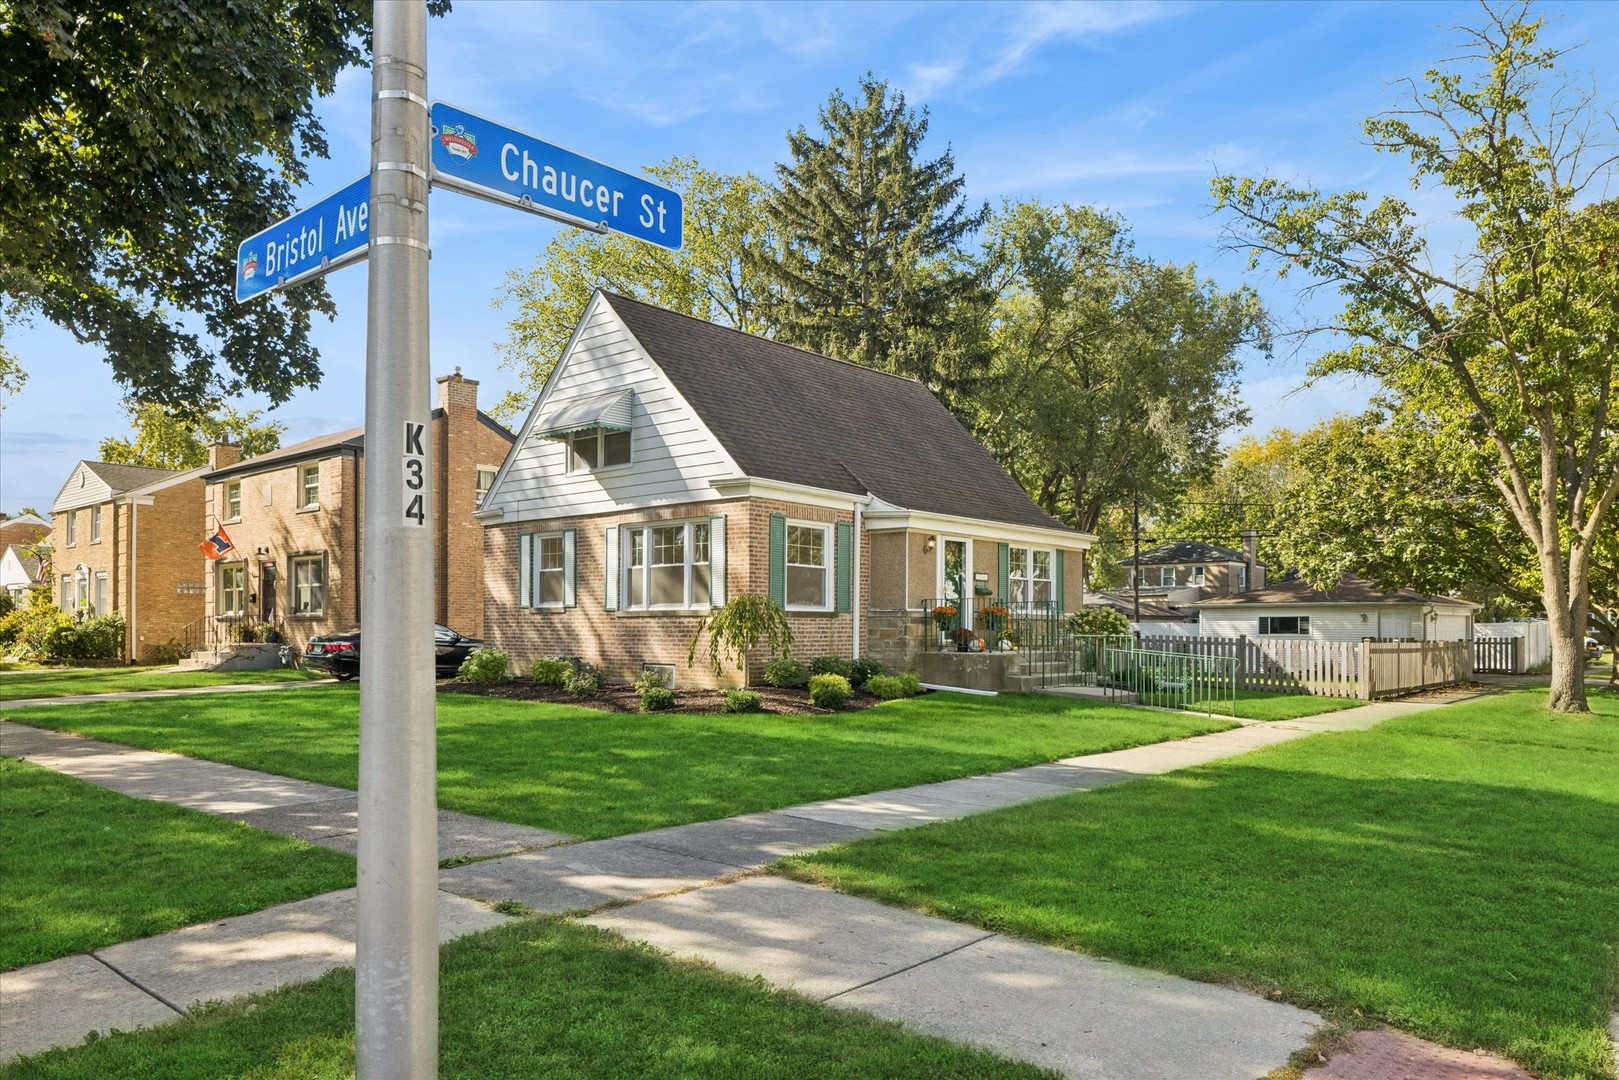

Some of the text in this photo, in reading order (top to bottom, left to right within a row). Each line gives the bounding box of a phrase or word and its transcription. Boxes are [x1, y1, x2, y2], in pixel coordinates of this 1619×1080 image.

[500, 142, 667, 234] Chaucer St
[265, 201, 369, 278] Bristol Ave
[405, 422, 425, 526] K34
